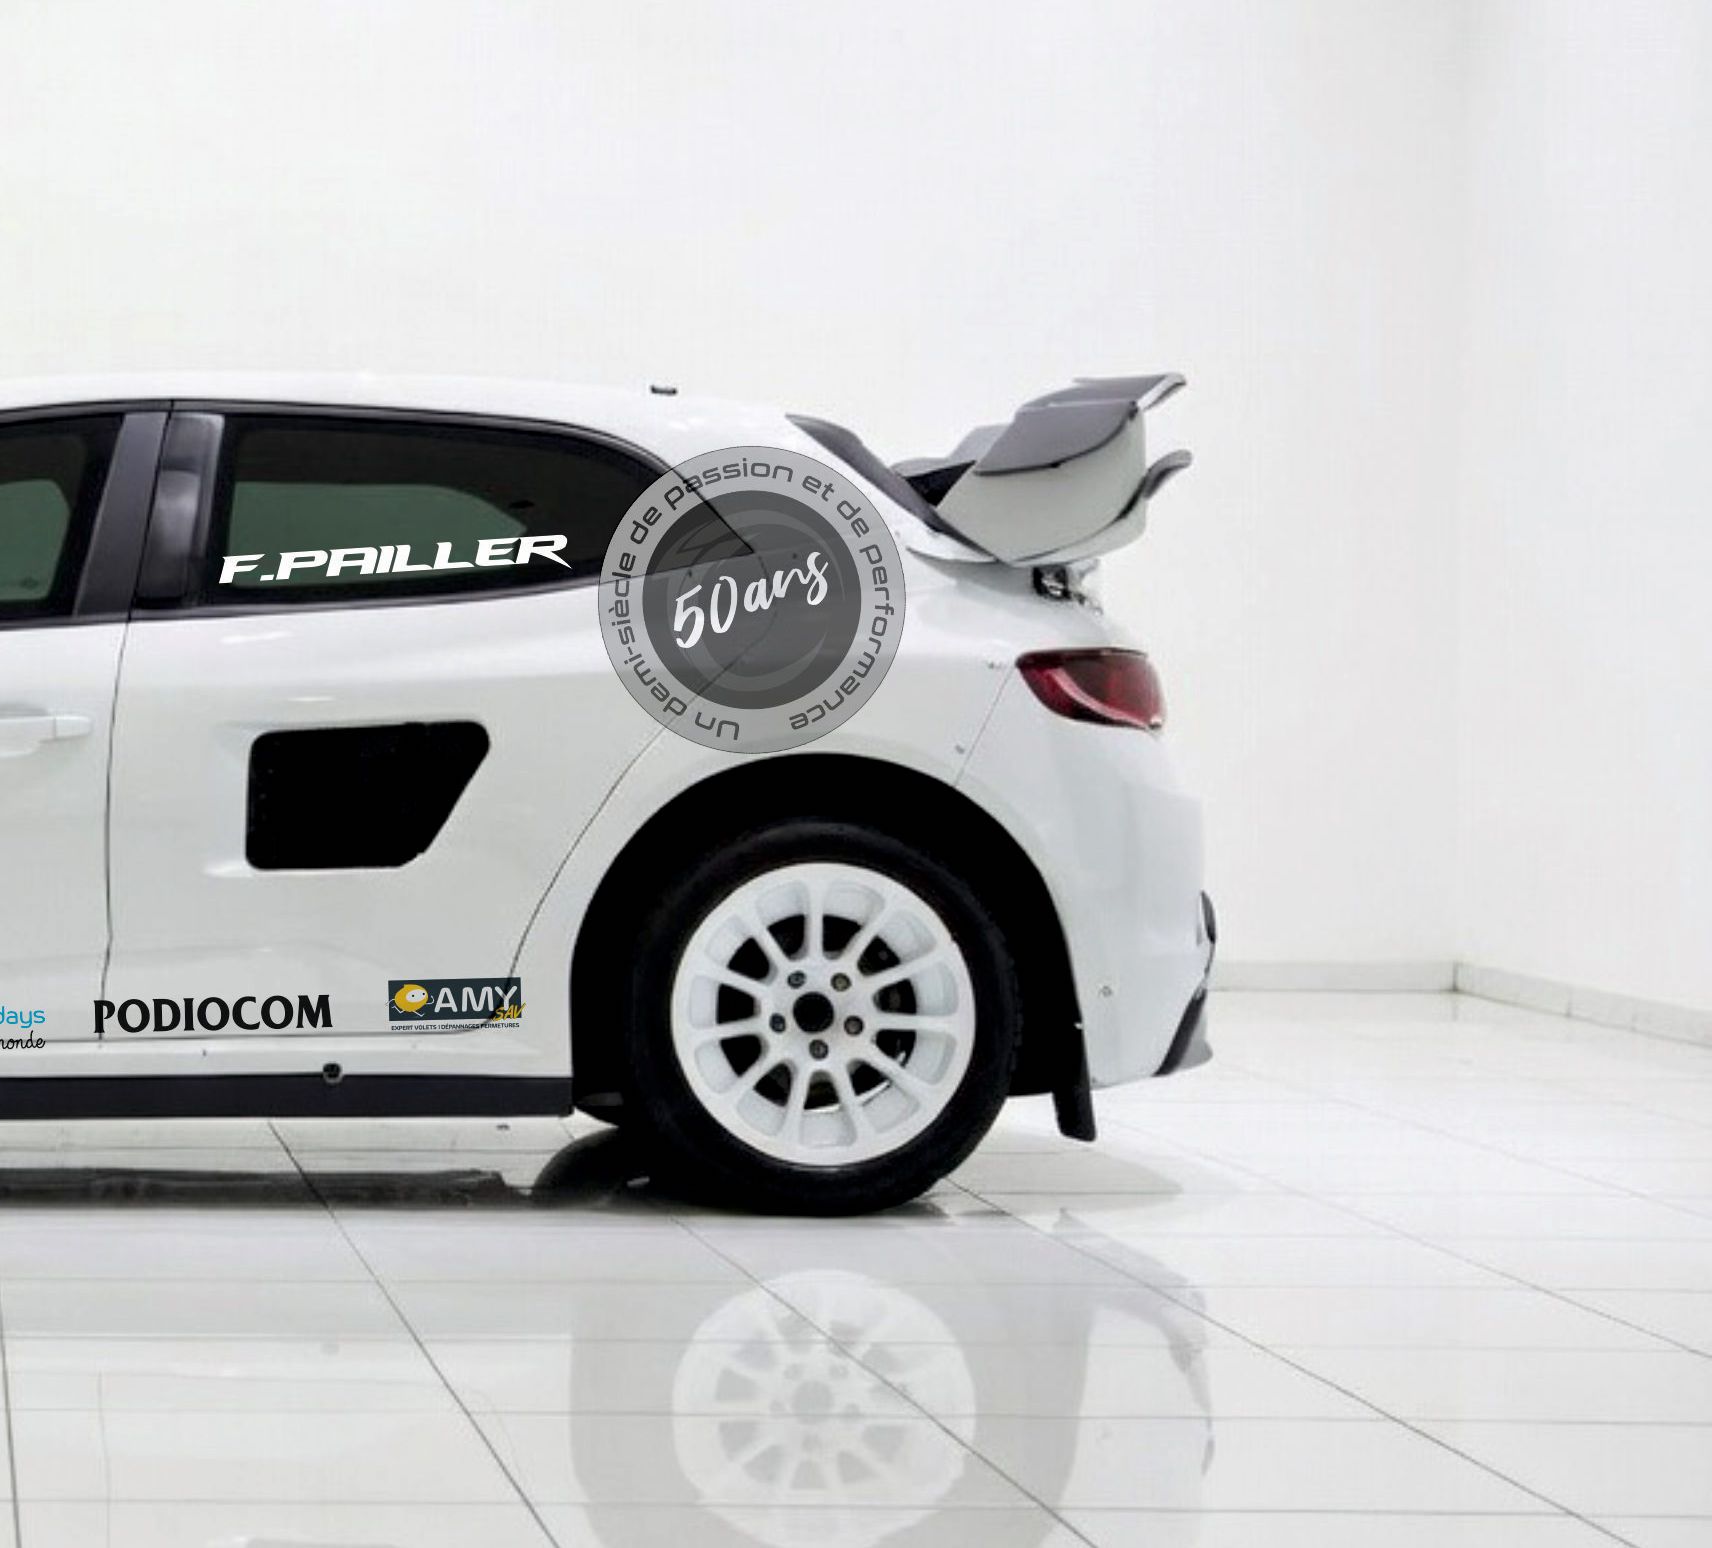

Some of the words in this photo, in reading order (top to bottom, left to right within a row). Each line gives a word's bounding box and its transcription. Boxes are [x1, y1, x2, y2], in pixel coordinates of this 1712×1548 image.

[663, 457, 794, 511] passion
[801, 475, 834, 502] et
[630, 506, 662, 545] de
[836, 500, 870, 539] de
[218, 534, 573, 584] F.PAILLER
[788, 544, 895, 730] performance
[694, 711, 740, 741] Un
[93, 994, 333, 1034] PODIOCOM
[434, 986, 518, 1013] AMY
[492, 1002, 526, 1022] SAV
